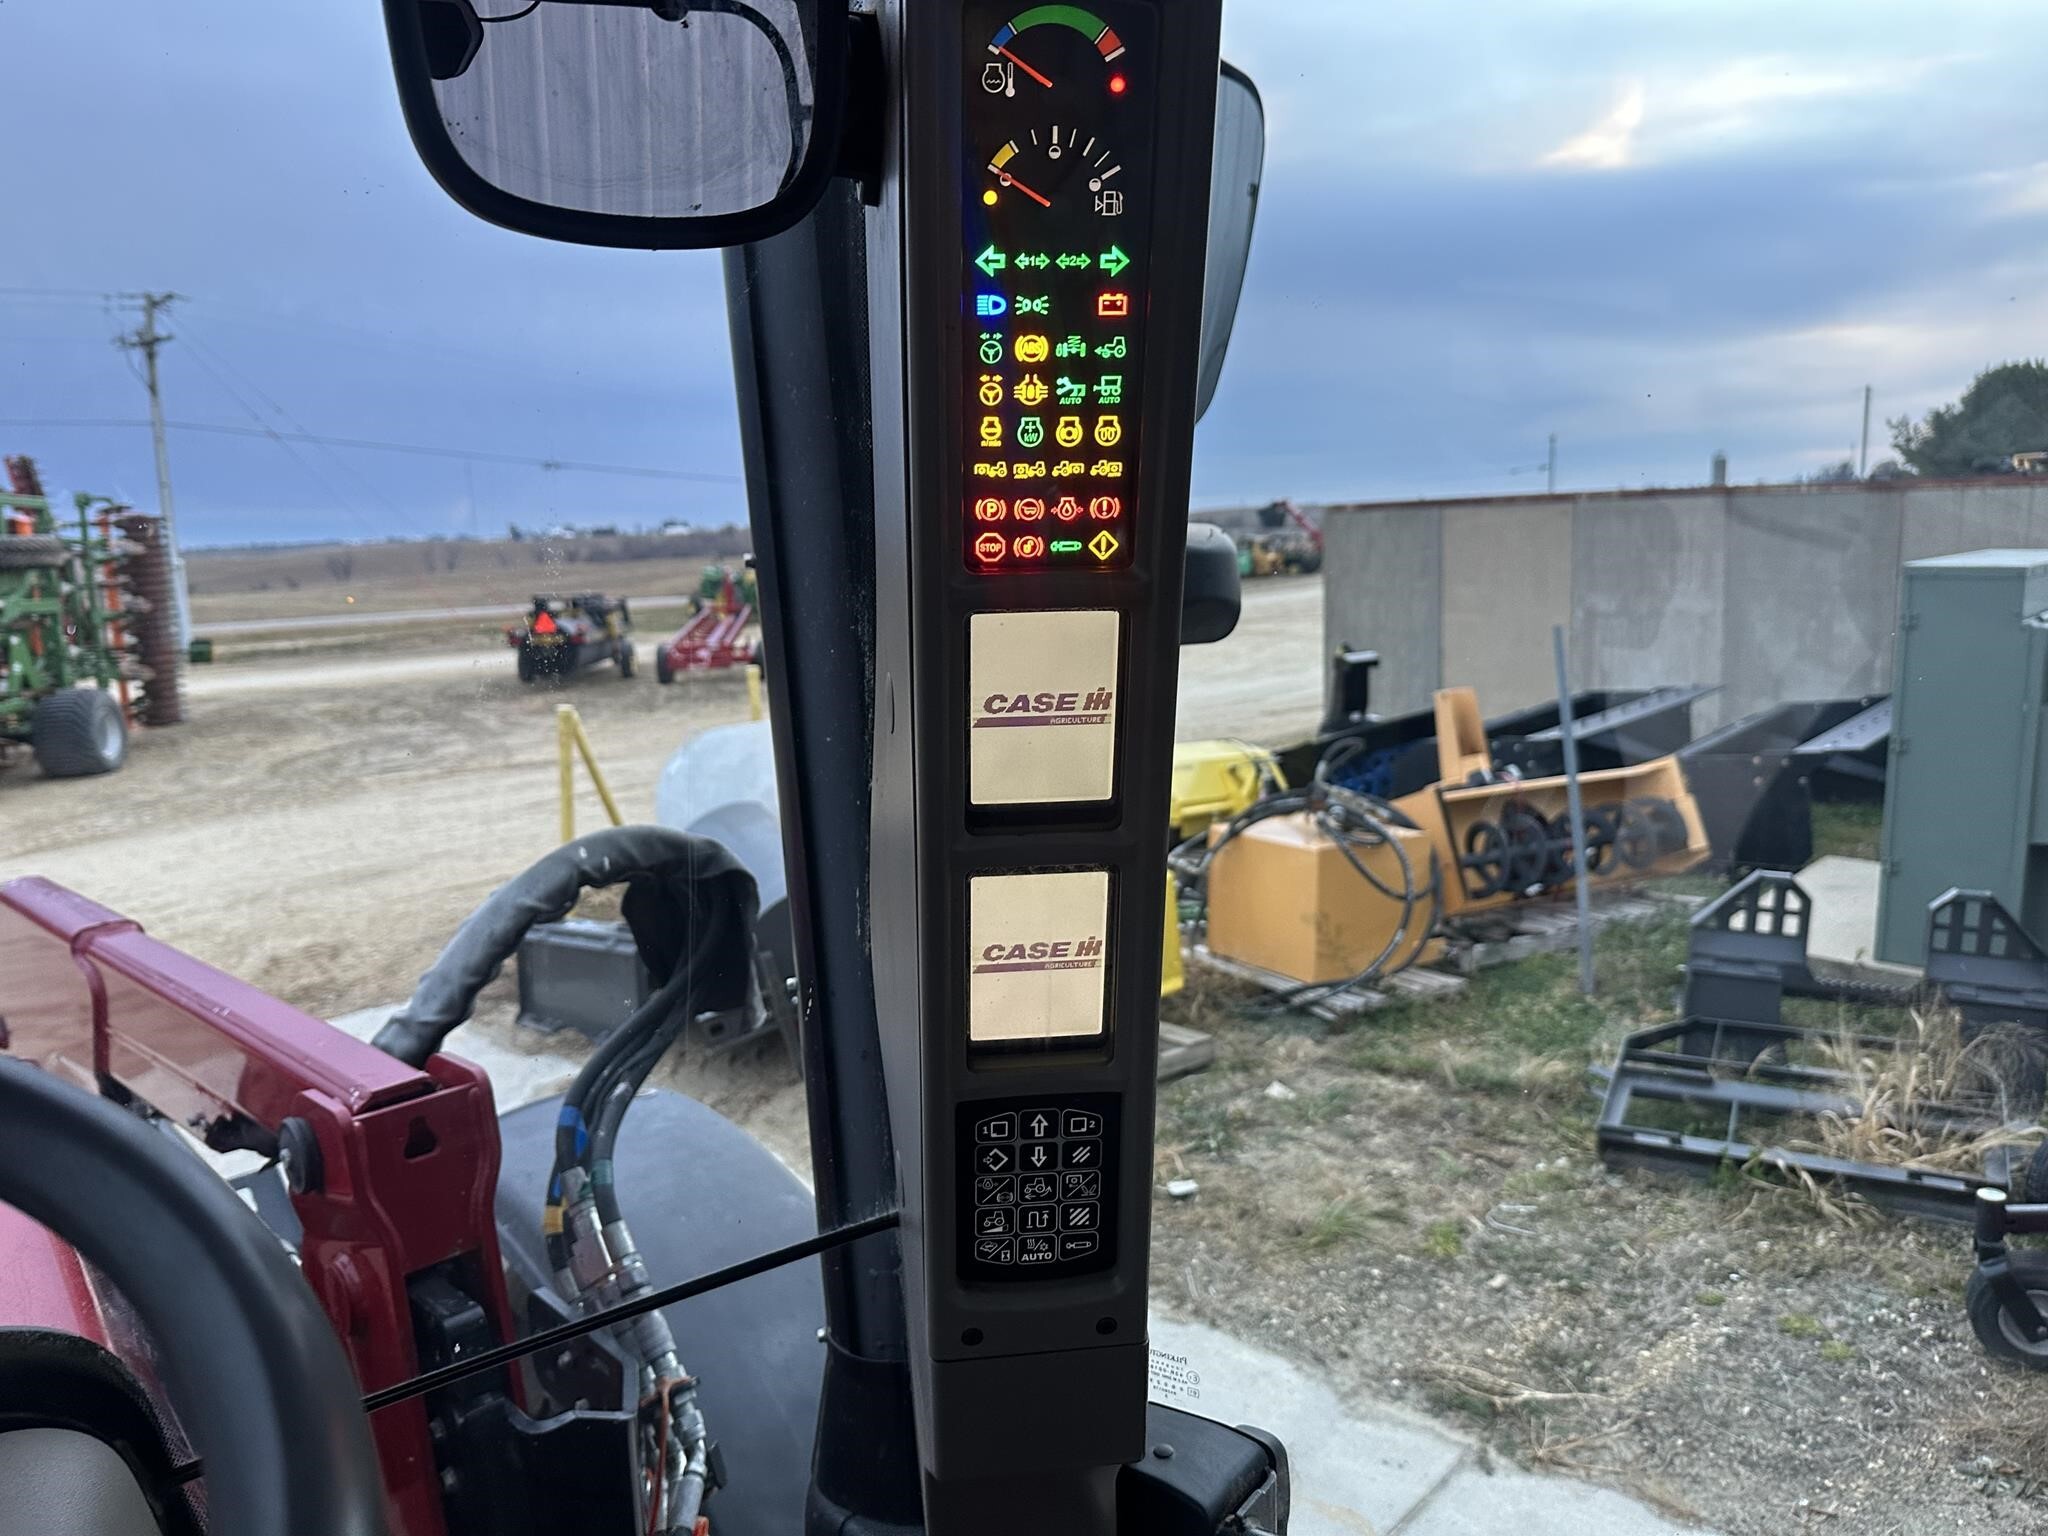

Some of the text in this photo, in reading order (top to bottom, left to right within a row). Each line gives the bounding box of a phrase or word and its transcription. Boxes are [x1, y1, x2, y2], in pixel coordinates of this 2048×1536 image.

[1059, 397, 1082, 405] AUTO
[1098, 396, 1121, 404] AUTO
[986, 502, 998, 518] P
[979, 543, 1002, 552] STOP
[983, 692, 1079, 714] CASE
[1050, 716, 1102, 724] AGRICULTURE
[982, 941, 1072, 962] CASE
[1044, 961, 1093, 969] AGRICULTURE
[1089, 1120, 1096, 1128] 2
[982, 1126, 989, 1135] 1
[1021, 1251, 1052, 1262] AUTO
